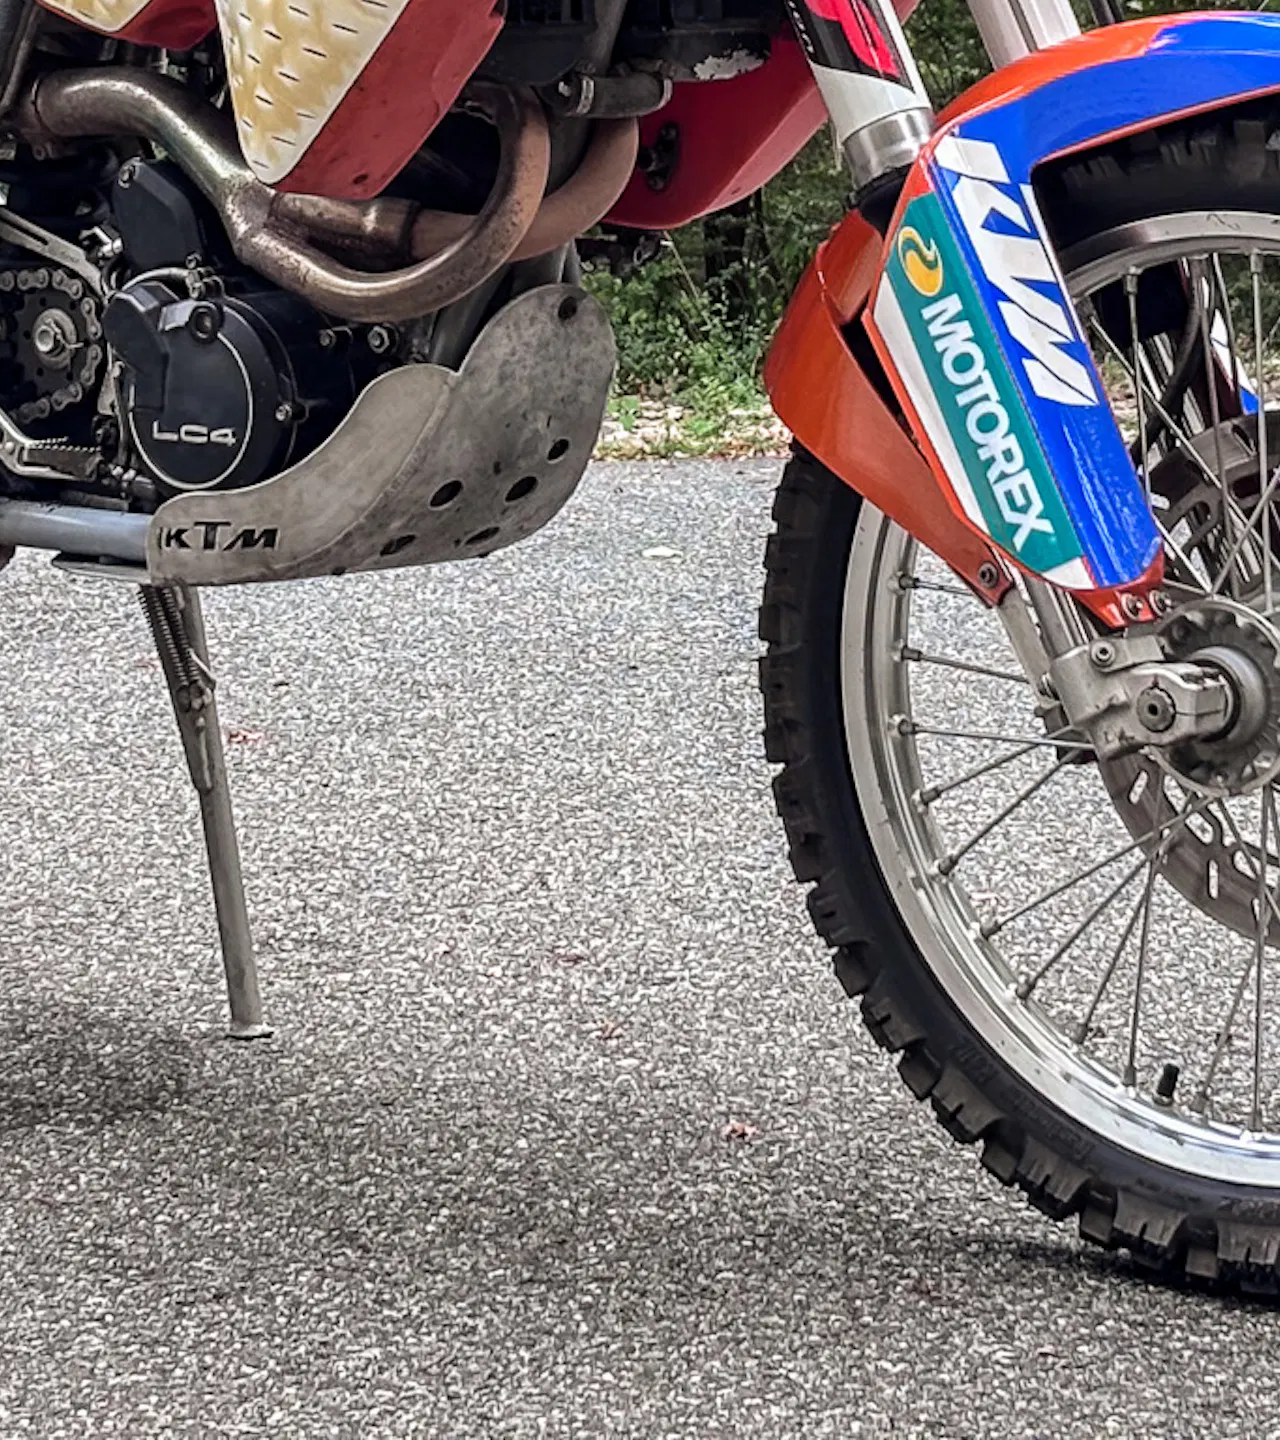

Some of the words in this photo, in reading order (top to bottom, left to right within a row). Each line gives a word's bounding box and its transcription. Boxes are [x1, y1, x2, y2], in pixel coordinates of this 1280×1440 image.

[934, 136, 1100, 407] KTM
[151, 420, 237, 447] LC4
[921, 292, 1055, 552] MOTOREX
[157, 521, 279, 552] KTM
